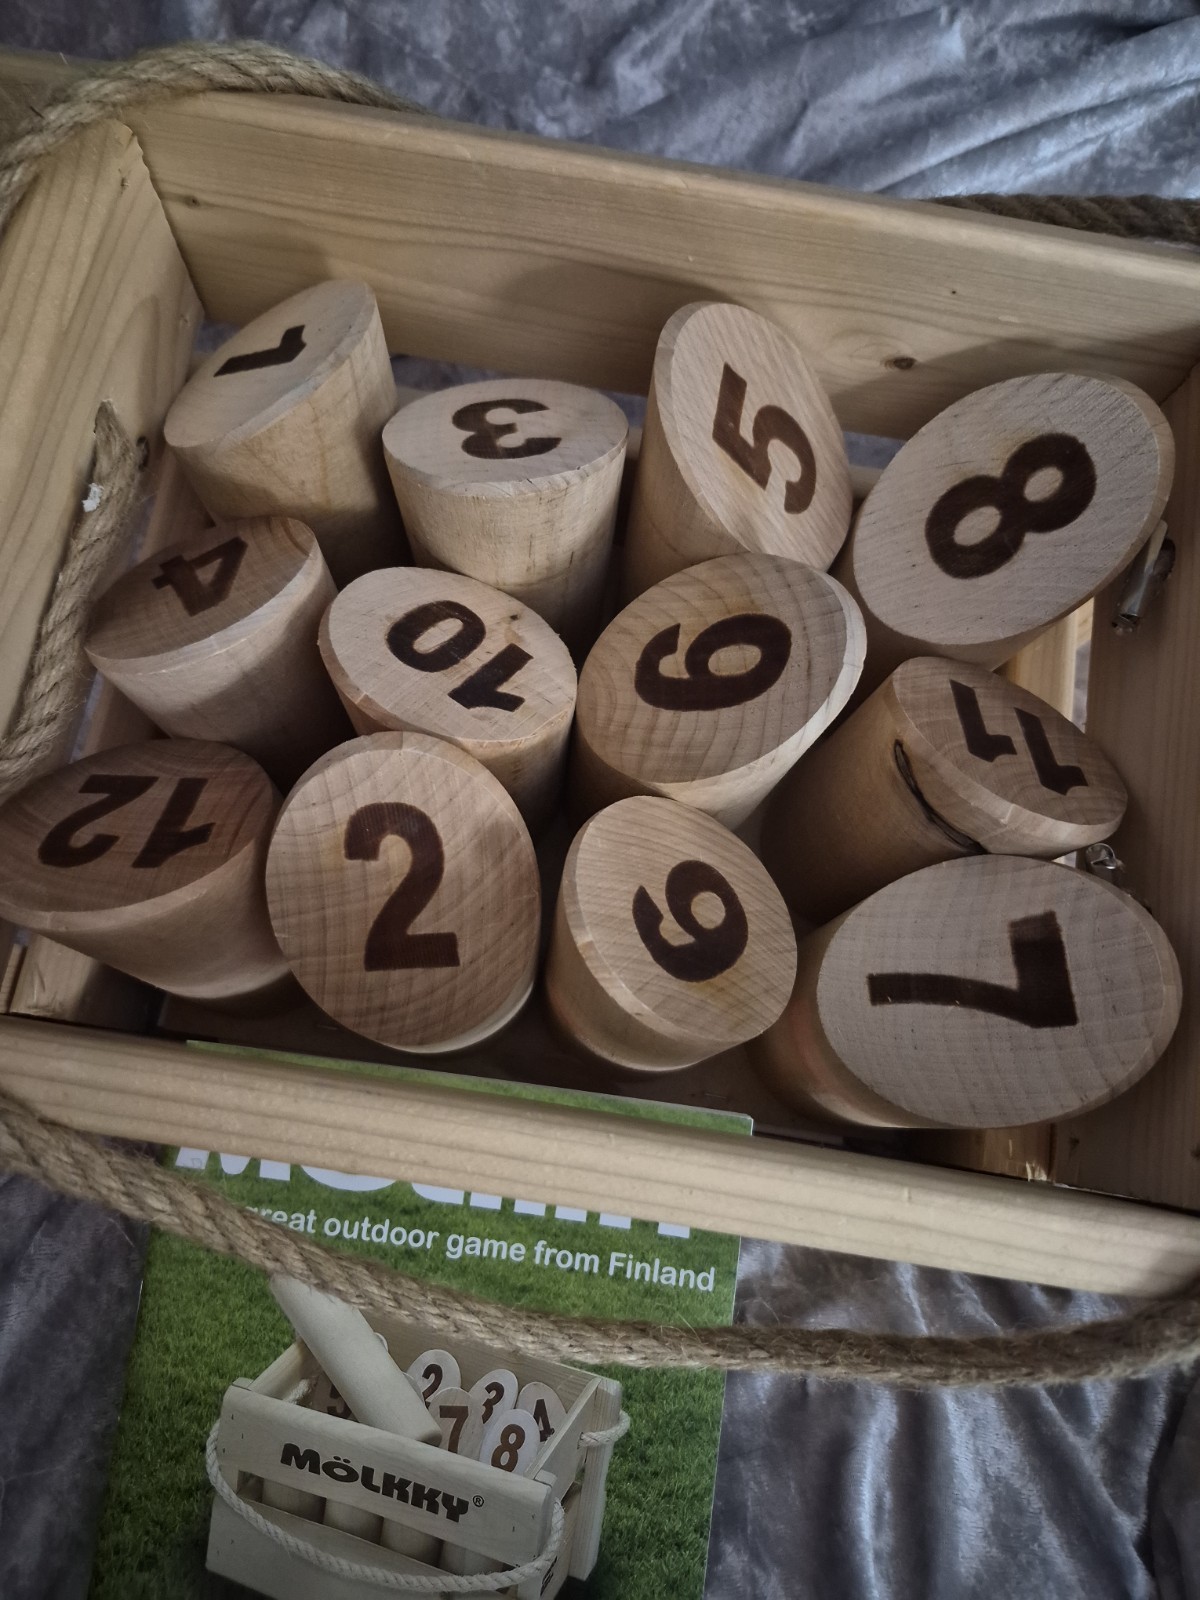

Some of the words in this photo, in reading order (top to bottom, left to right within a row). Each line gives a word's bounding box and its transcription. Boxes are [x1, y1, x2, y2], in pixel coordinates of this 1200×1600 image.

[214, 325, 306, 377] 1
[451, 398, 562, 459] 3
[712, 362, 817, 514] 5
[924, 432, 1096, 580] 8
[153, 536, 249, 616] 4
[386, 600, 534, 712] 10
[948, 678, 1088, 796] 11
[38, 774, 215, 869] 12
[343, 802, 460, 972] 2
[868, 910, 1078, 1028] 7
[246, 1206, 316, 1233] reat
[324, 1217, 440, 1249] outdoor
[446, 1233, 526, 1262] game
[534, 1240, 600, 1274] from
[608, 1252, 715, 1293] Finland
[439, 1405, 469, 1453] 7
[491, 1424, 526, 1473] 8
